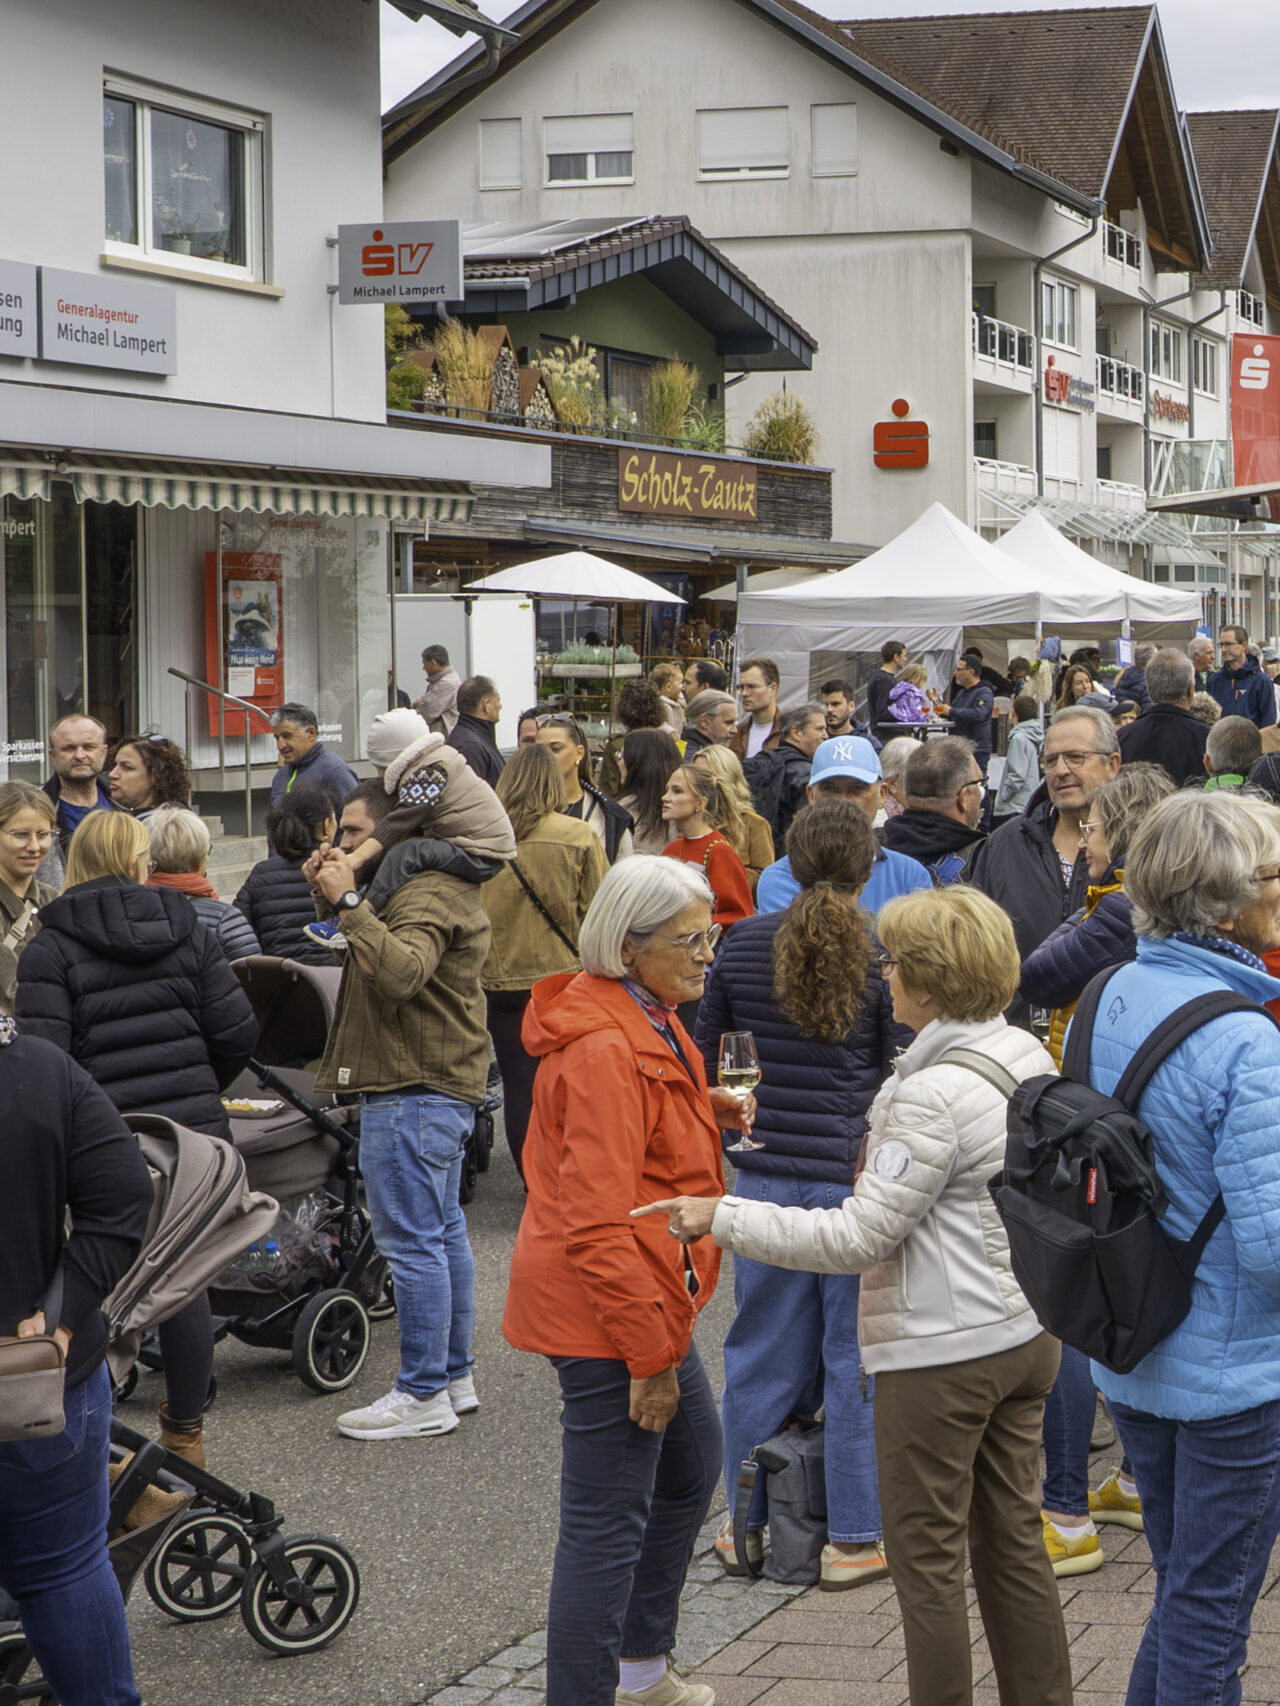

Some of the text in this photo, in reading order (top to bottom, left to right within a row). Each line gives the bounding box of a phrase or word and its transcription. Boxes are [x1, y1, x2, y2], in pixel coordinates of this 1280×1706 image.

[353, 285, 446, 298] Michael Lampert
[57, 298, 140, 325] Generalagentur
[57, 321, 167, 356] Michael Lampert
[621, 454, 756, 518] Scholz-Tautz
[1, 740, 44, 753] Sparkassen
[832, 741, 854, 761] NY
